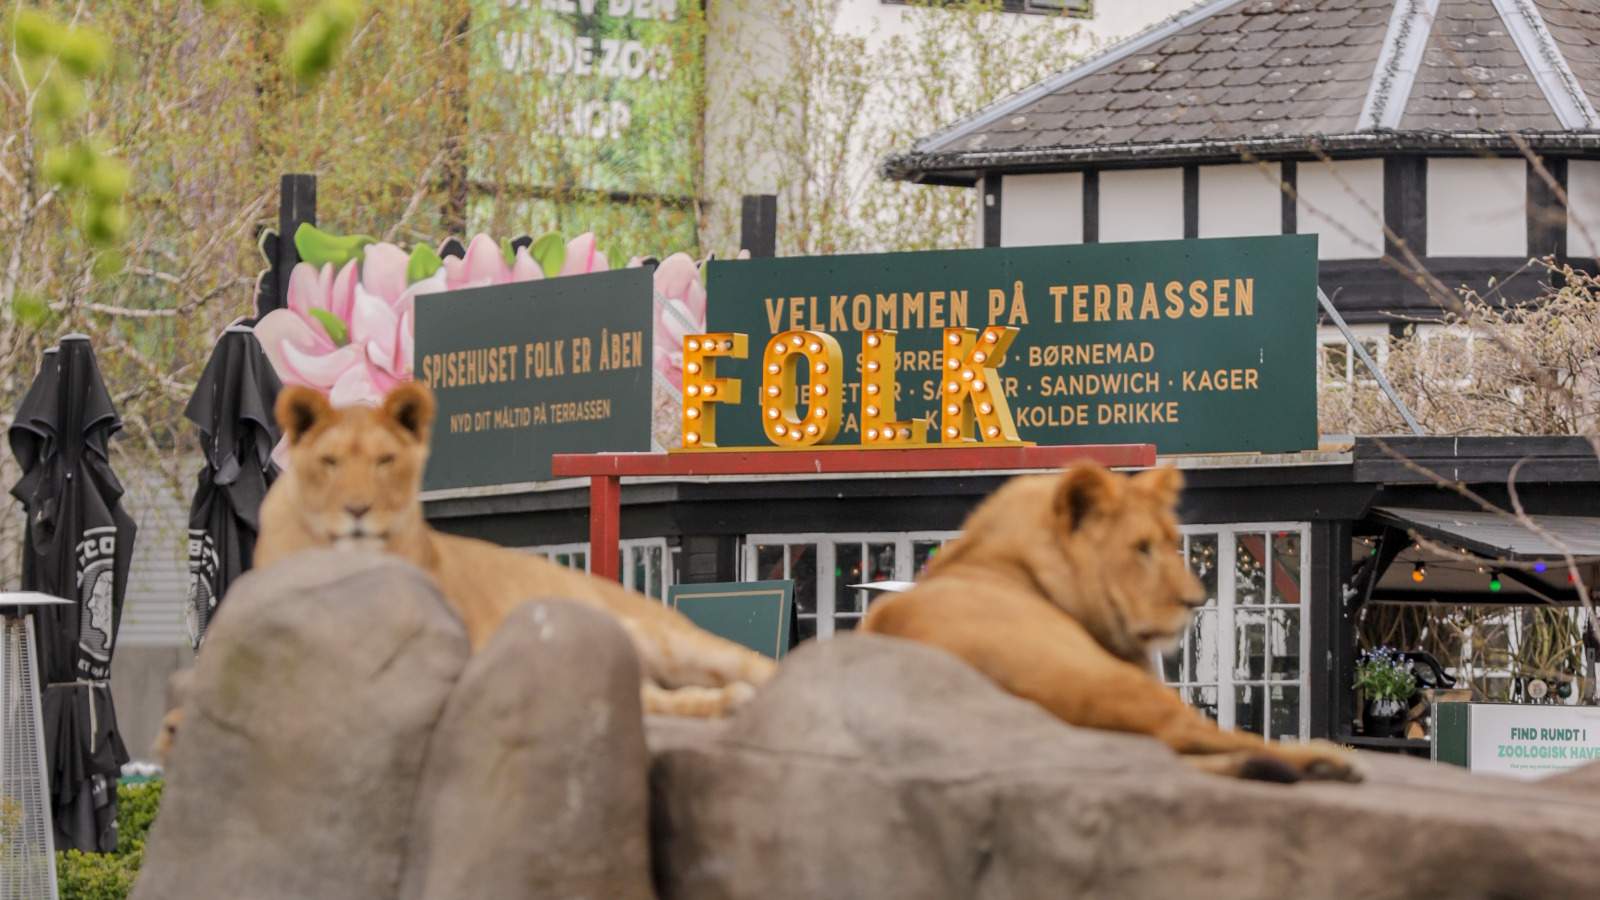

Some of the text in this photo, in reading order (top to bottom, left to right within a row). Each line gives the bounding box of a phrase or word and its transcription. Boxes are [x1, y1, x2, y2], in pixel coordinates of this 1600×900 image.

[600, 39, 673, 80] ZOO
[765, 278, 1254, 334] VELKOMMEN PÅ TERRASSEN
[422, 328, 642, 389] SPISEHUSET FOLK ER ÅBEN
[1029, 342, 1155, 367] BØRNEMAD
[683, 325, 1020, 448] FOLK
[1040, 372, 1159, 396] SANDWICH
[1182, 369, 1259, 391] KAGER
[450, 399, 611, 433] NYD DIT MÅLTID PÅ TERRASSEN
[1016, 402, 1179, 427] KOLDE DRIKKE
[1511, 727, 1586, 741] FIND RUNDT I
[1498, 745, 1567, 758] ZOOLOGISK
